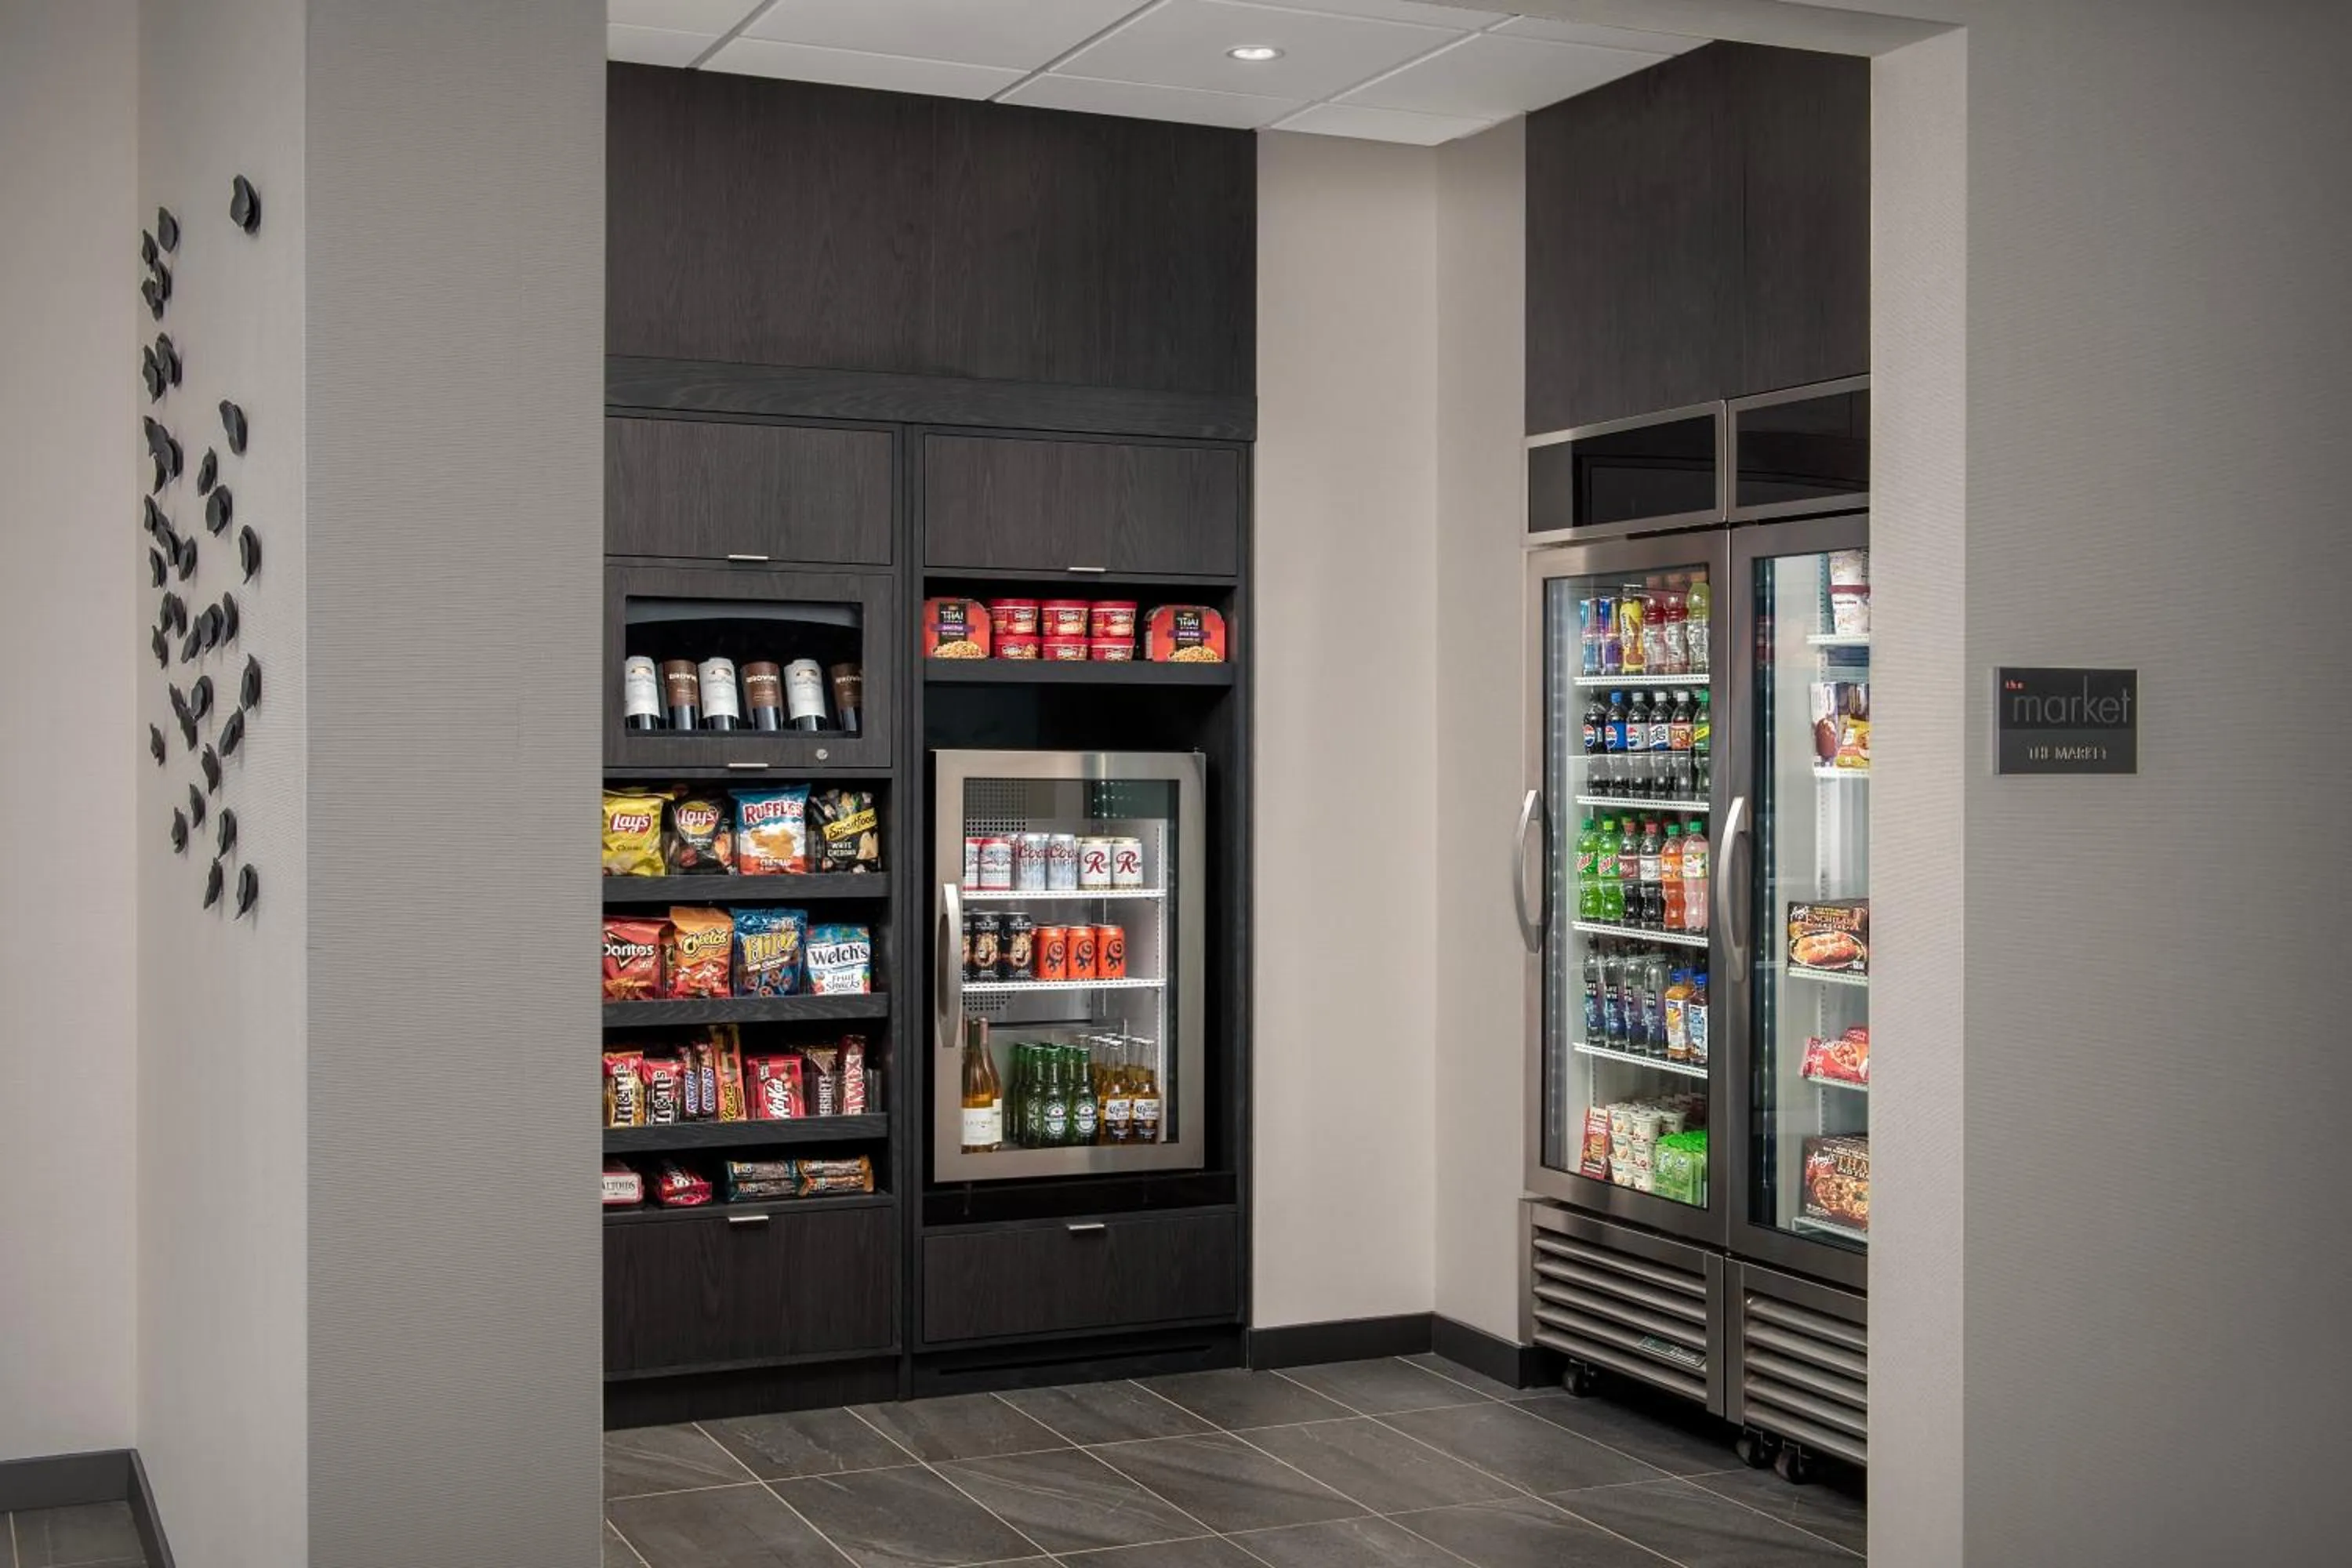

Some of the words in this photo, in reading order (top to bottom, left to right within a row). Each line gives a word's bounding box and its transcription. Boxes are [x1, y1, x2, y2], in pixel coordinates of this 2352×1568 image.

[2005, 680, 2024, 690] the
[2013, 675, 2131, 724] market
[2028, 746, 2049, 760] THE
[2055, 746, 2107, 760] MARKET
[745, 802, 804, 823] RUFFLES
[683, 929, 727, 954] Cheetos
[812, 945, 868, 965] Welch's
